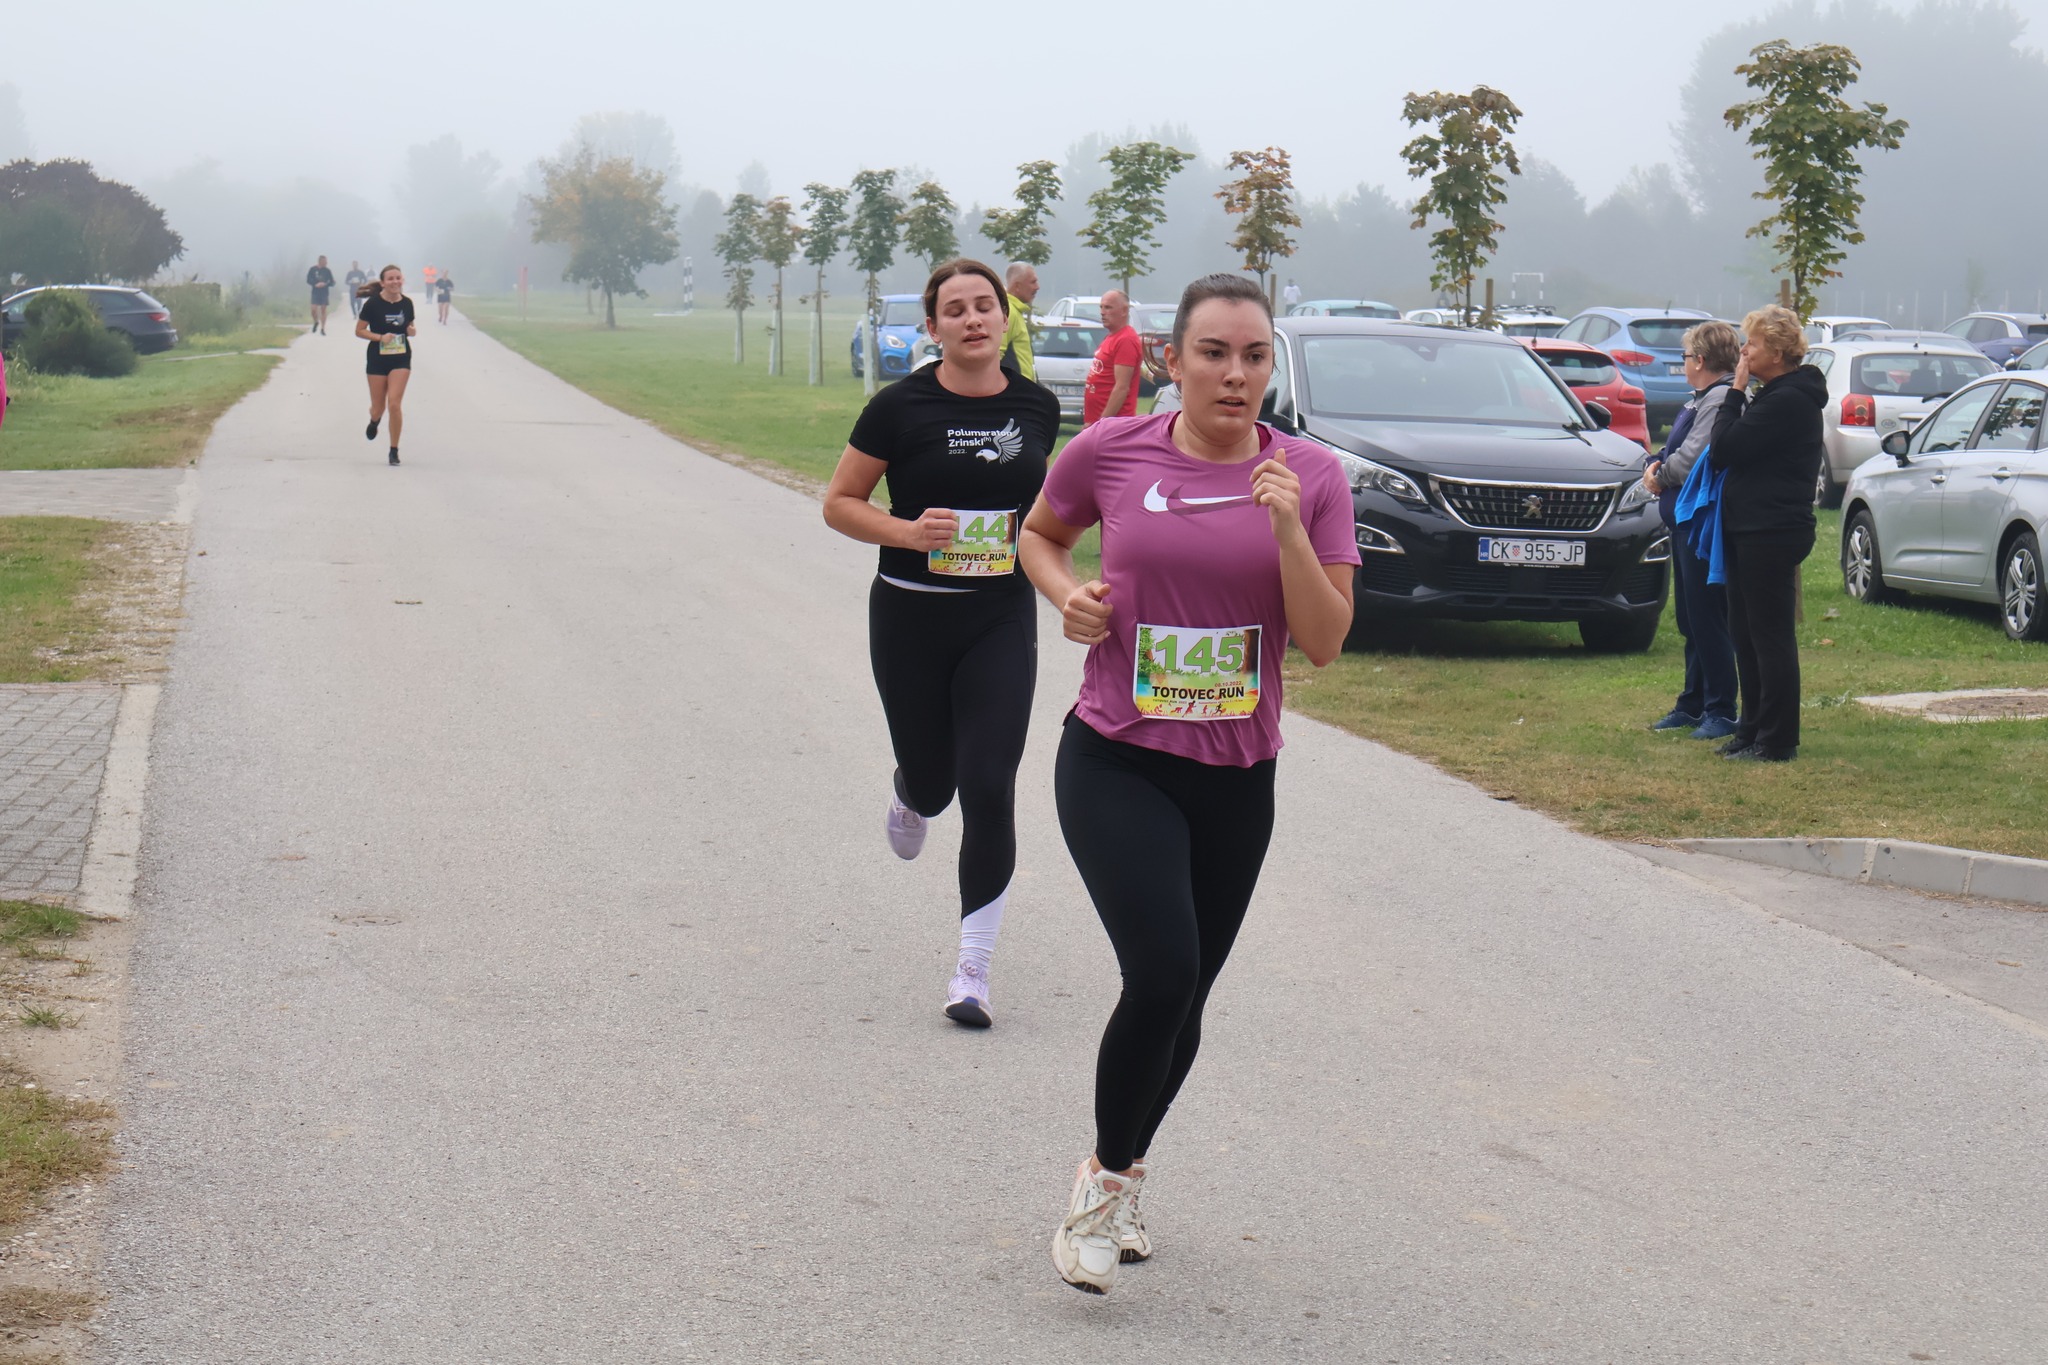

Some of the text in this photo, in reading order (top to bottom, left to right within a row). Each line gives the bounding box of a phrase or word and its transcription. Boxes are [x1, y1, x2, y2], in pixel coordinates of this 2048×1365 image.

[947, 428, 1013, 437] Polumaraton
[942, 552, 1007, 561] TOTOVEC RUN
[1491, 541, 1583, 562] CK 955-JP
[1155, 634, 1243, 673] 145
[1152, 686, 1244, 700] TOTOVEC RUN
